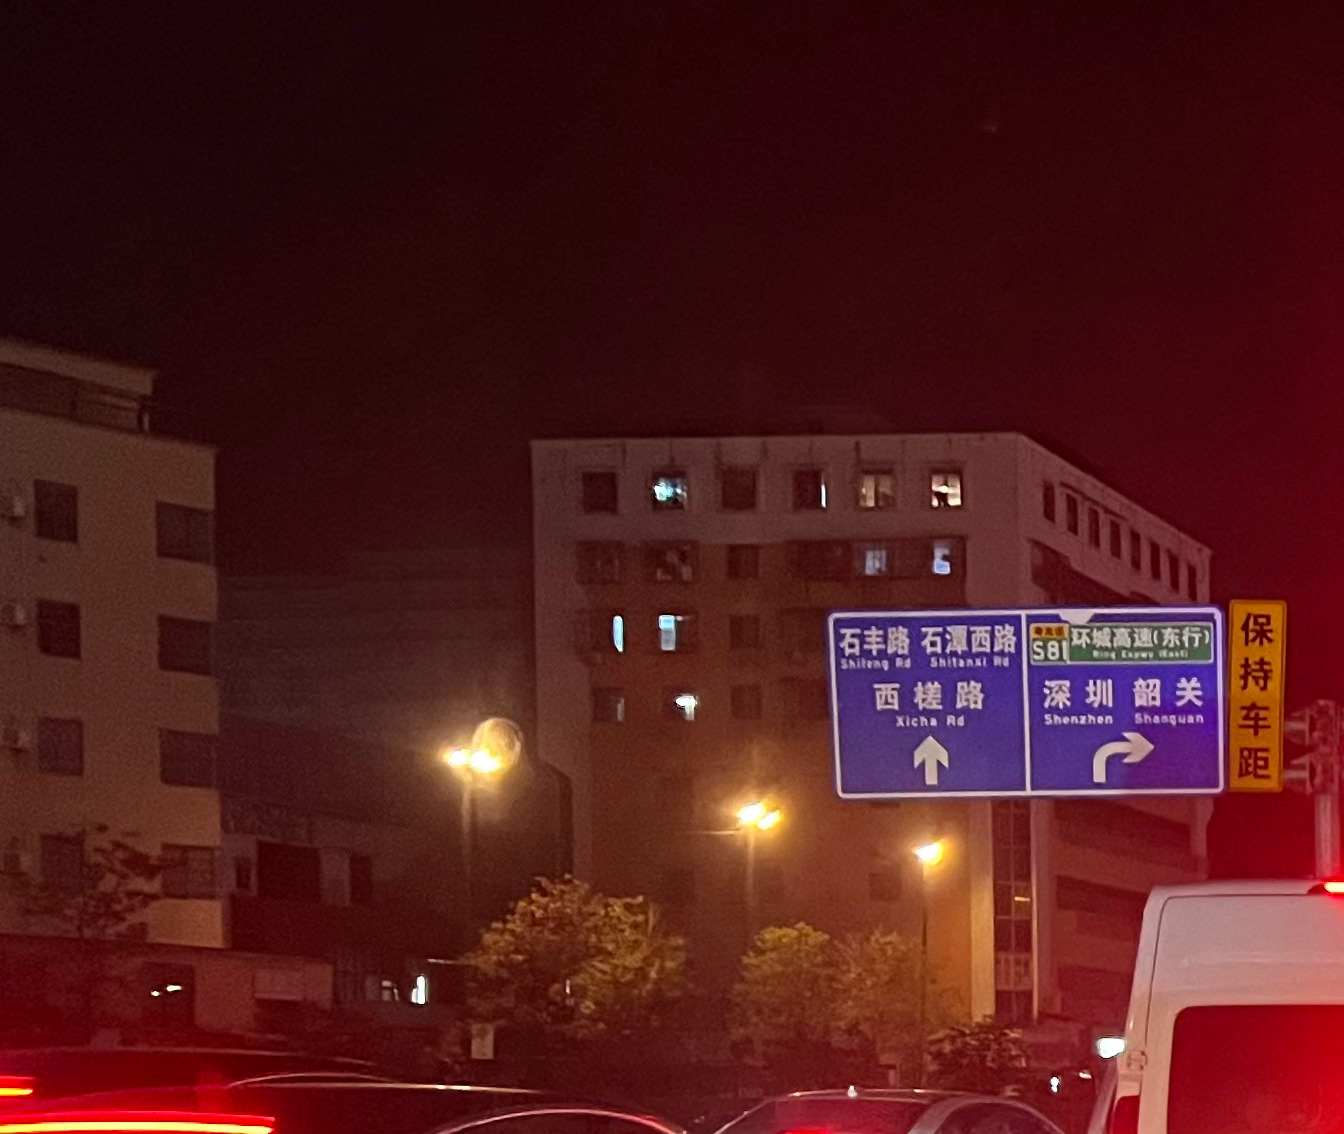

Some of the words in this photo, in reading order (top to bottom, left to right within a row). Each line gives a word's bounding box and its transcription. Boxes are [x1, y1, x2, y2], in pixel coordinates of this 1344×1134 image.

[840, 626, 911, 656] 石丰路
[921, 625, 1016, 655] 石潭西路
[1032, 642, 1068, 661] S81
[896, 657, 911, 668] Rd
[993, 655, 1010, 667] Rd
[1043, 679, 1113, 709] 深圳
[1134, 678, 1203, 708] 韶关
[1238, 613, 1275, 780] 保持车距
[896, 714, 938, 727] Xicha
[946, 714, 965, 727] Rd
[1044, 713, 1114, 725] Shenzhen
[1135, 713, 1204, 726] Shaoguan
